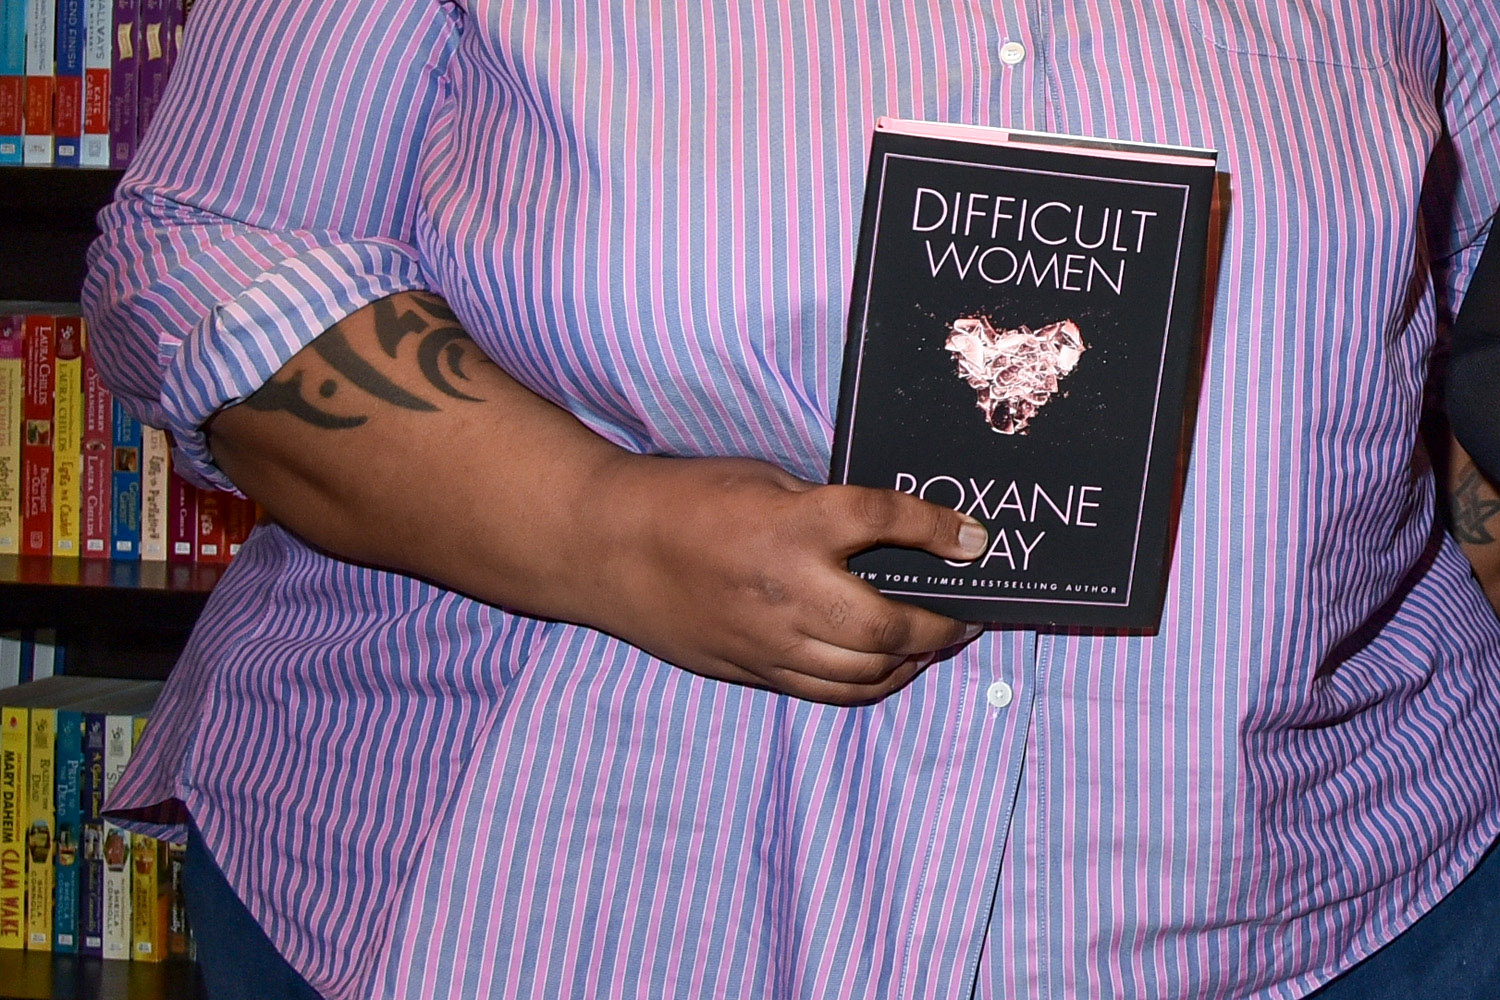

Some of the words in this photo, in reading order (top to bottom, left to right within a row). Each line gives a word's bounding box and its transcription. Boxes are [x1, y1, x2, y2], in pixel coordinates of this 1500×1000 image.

[912, 187, 1158, 254] DIFFICULT
[926, 240, 1126, 295] WOMEN
[886, 574, 918, 584] YORK
[928, 577, 964, 587] TIMES
[972, 579, 1058, 592] BESTSELLING
[1066, 584, 1118, 594] AUTHOR
[4, 750, 14, 788] MARY
[2, 791, 14, 842] DAHEIM
[2, 849, 20, 889] CLAM
[1, 897, 20, 937] WAKE
